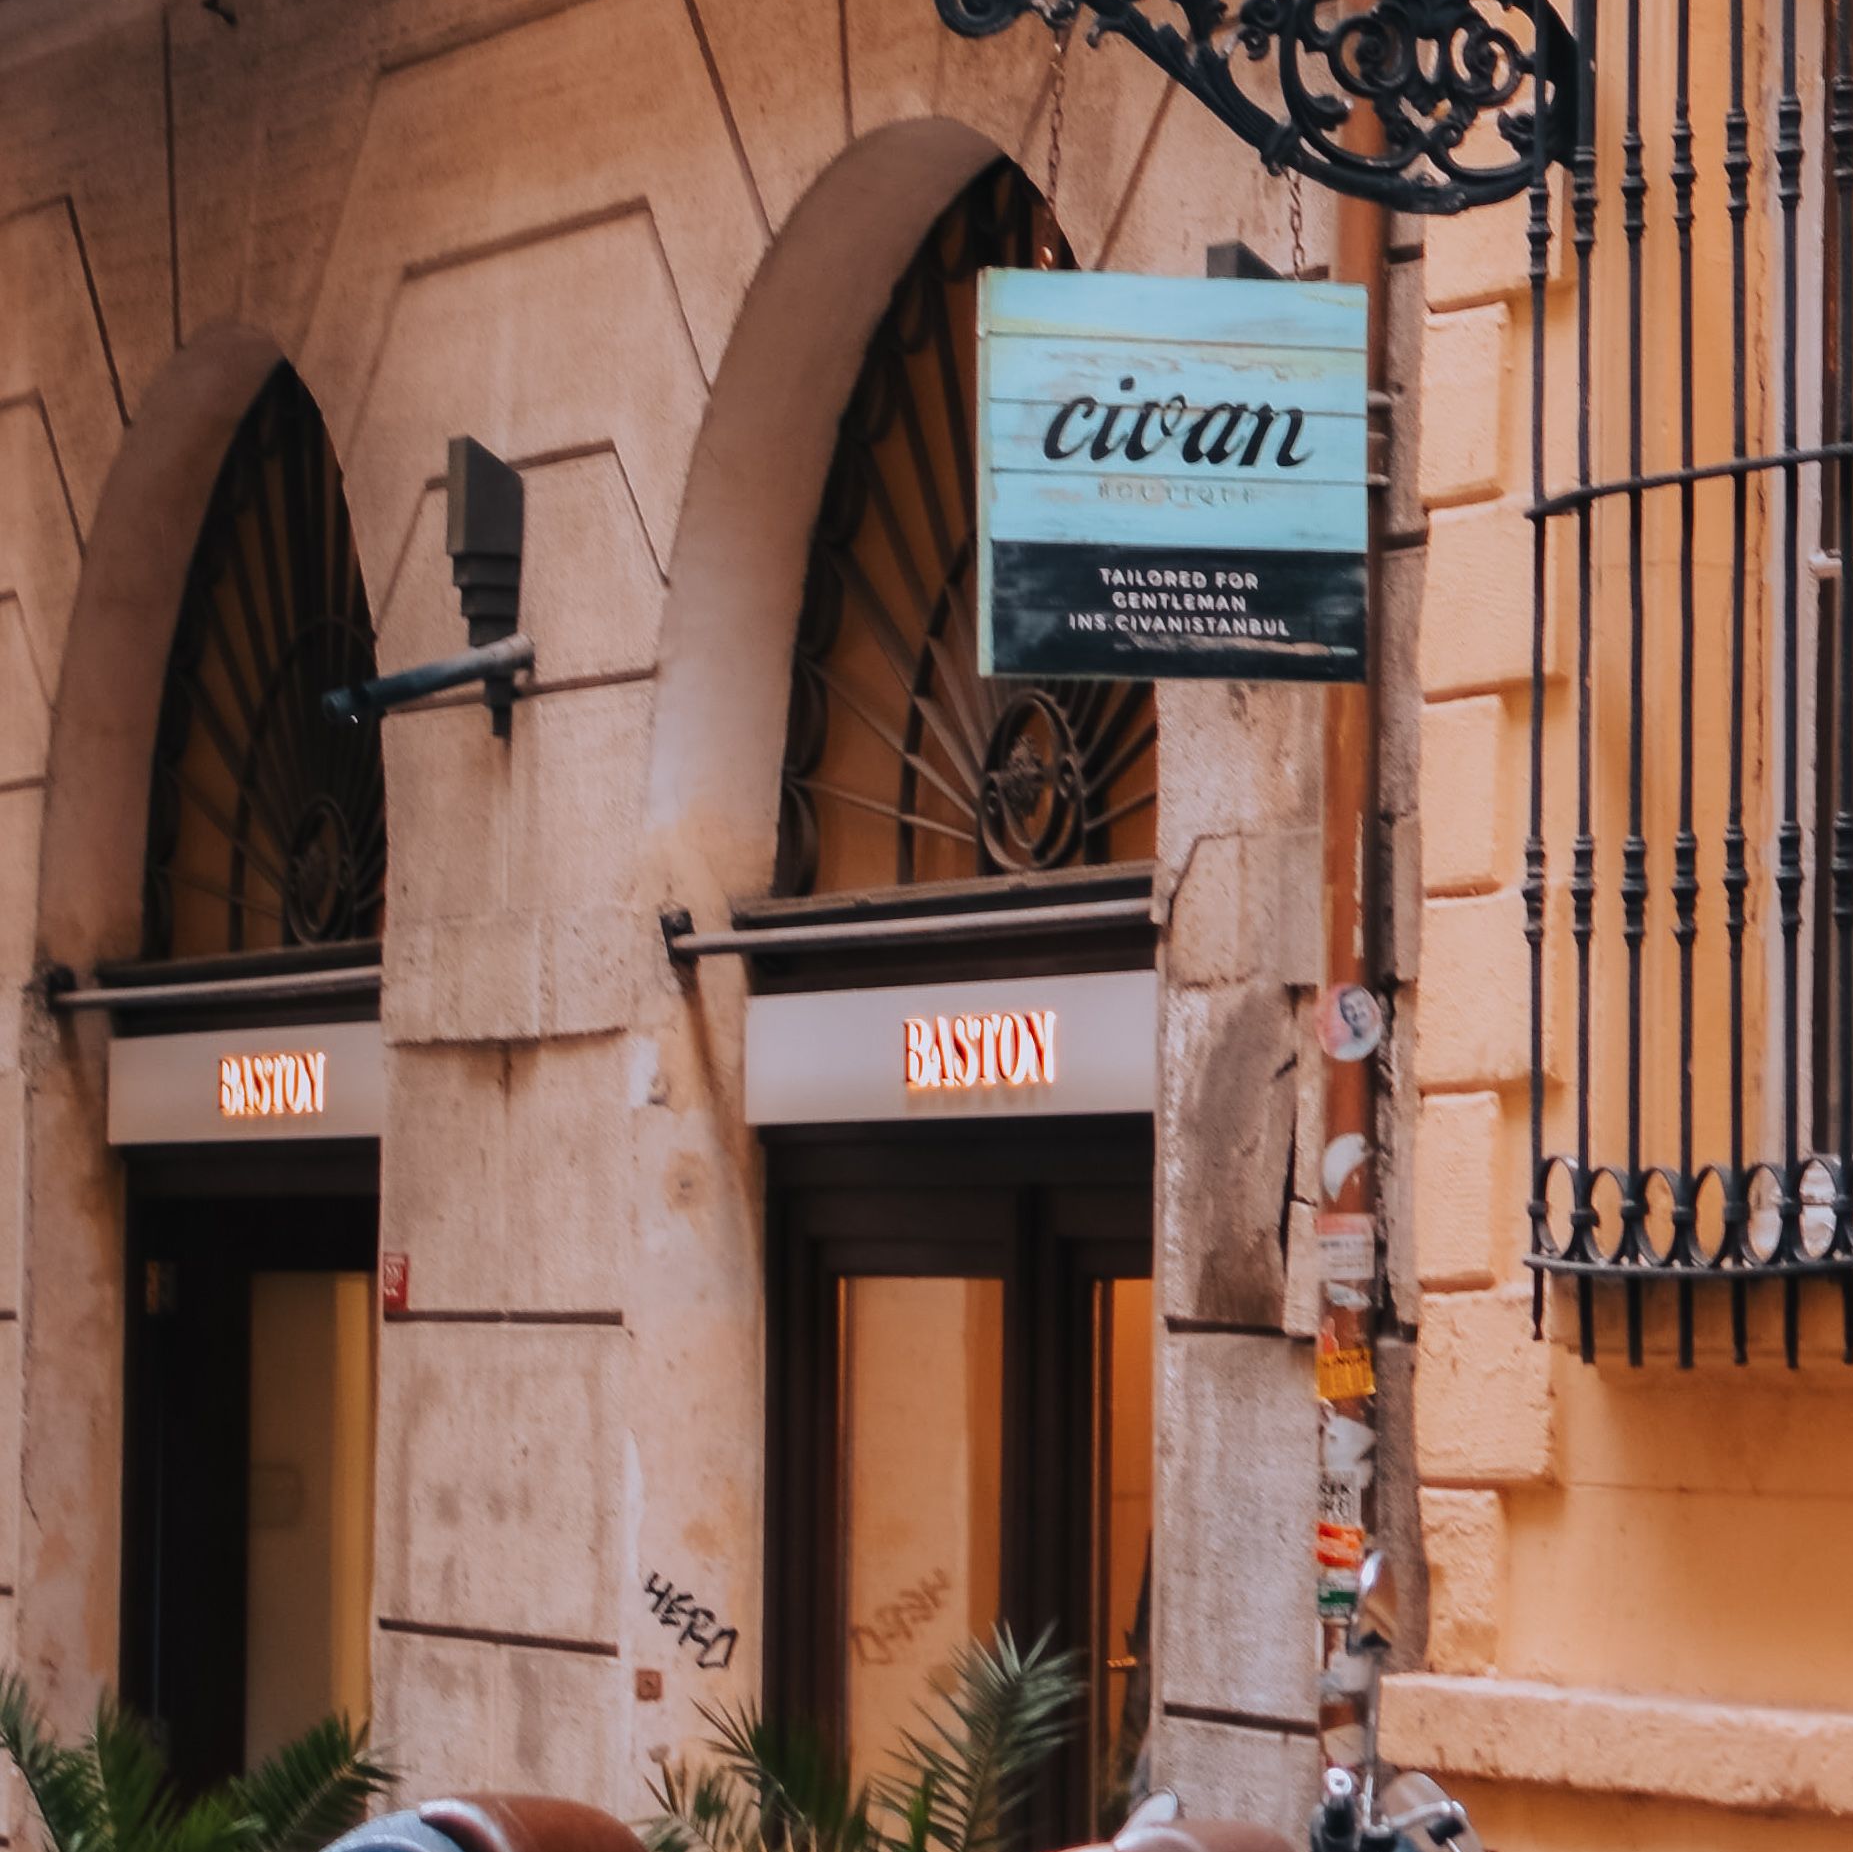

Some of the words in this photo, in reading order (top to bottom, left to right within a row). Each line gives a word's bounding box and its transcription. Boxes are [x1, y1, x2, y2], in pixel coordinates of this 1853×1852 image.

[1044, 376, 1314, 468] civan
[1099, 568, 1207, 589] TAILORED
[1215, 571, 1259, 590] FOR
[1112, 591, 1247, 612] GENTLEMAN
[904, 1010, 1057, 1088] BASTON
[219, 1052, 326, 1116] BASTON
